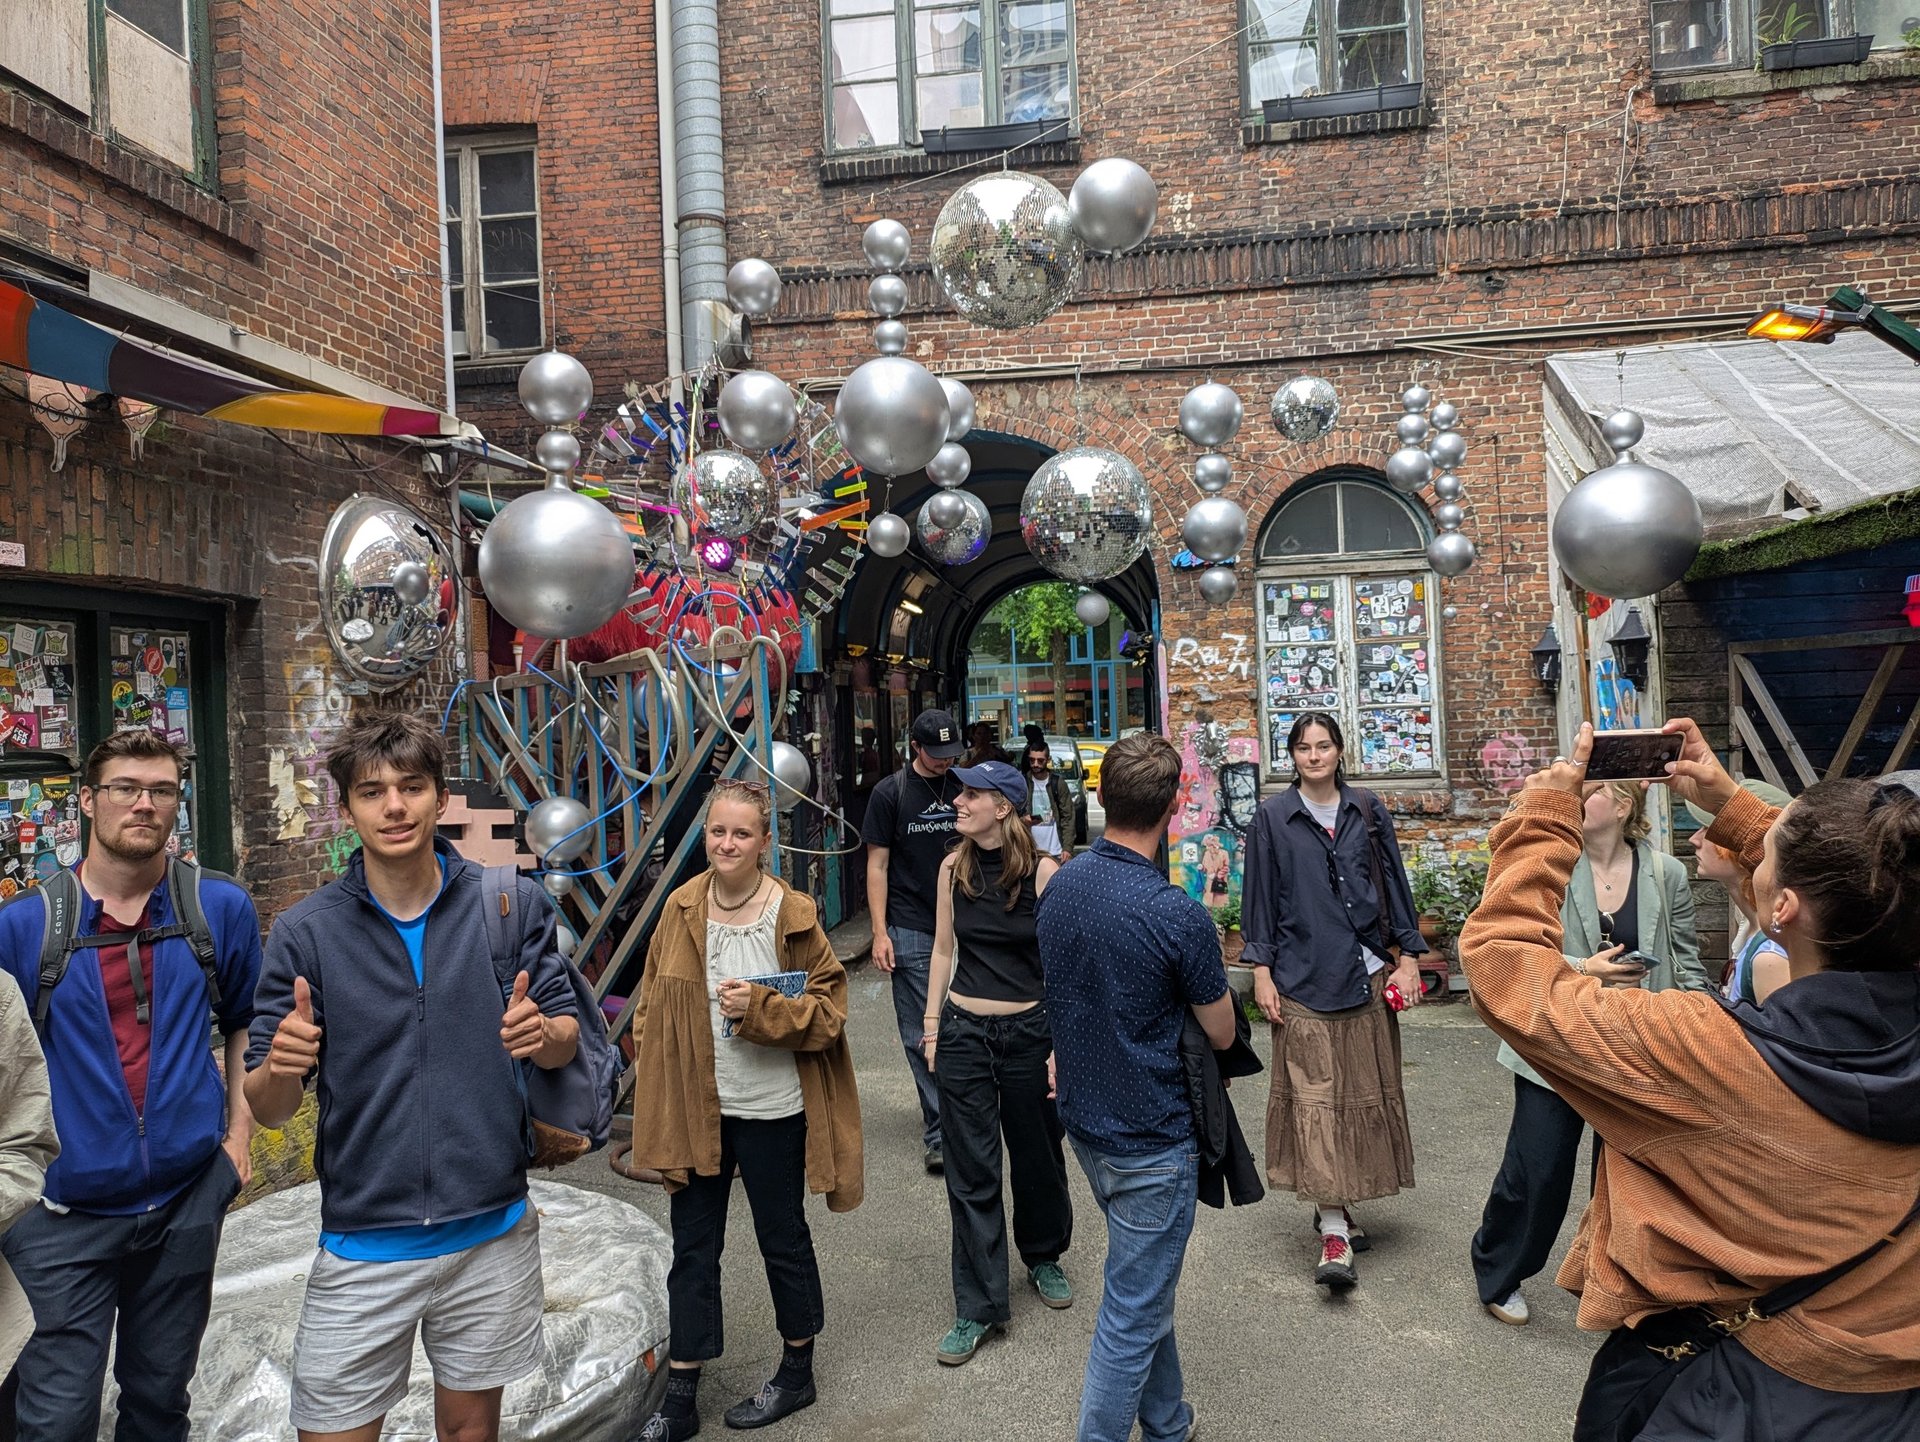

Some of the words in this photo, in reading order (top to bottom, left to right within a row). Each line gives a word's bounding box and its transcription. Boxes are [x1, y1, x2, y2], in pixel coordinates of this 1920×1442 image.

[43, 655, 60, 666] WGS
[14, 727, 29, 739] FCK
[55, 897, 63, 935] osprey
